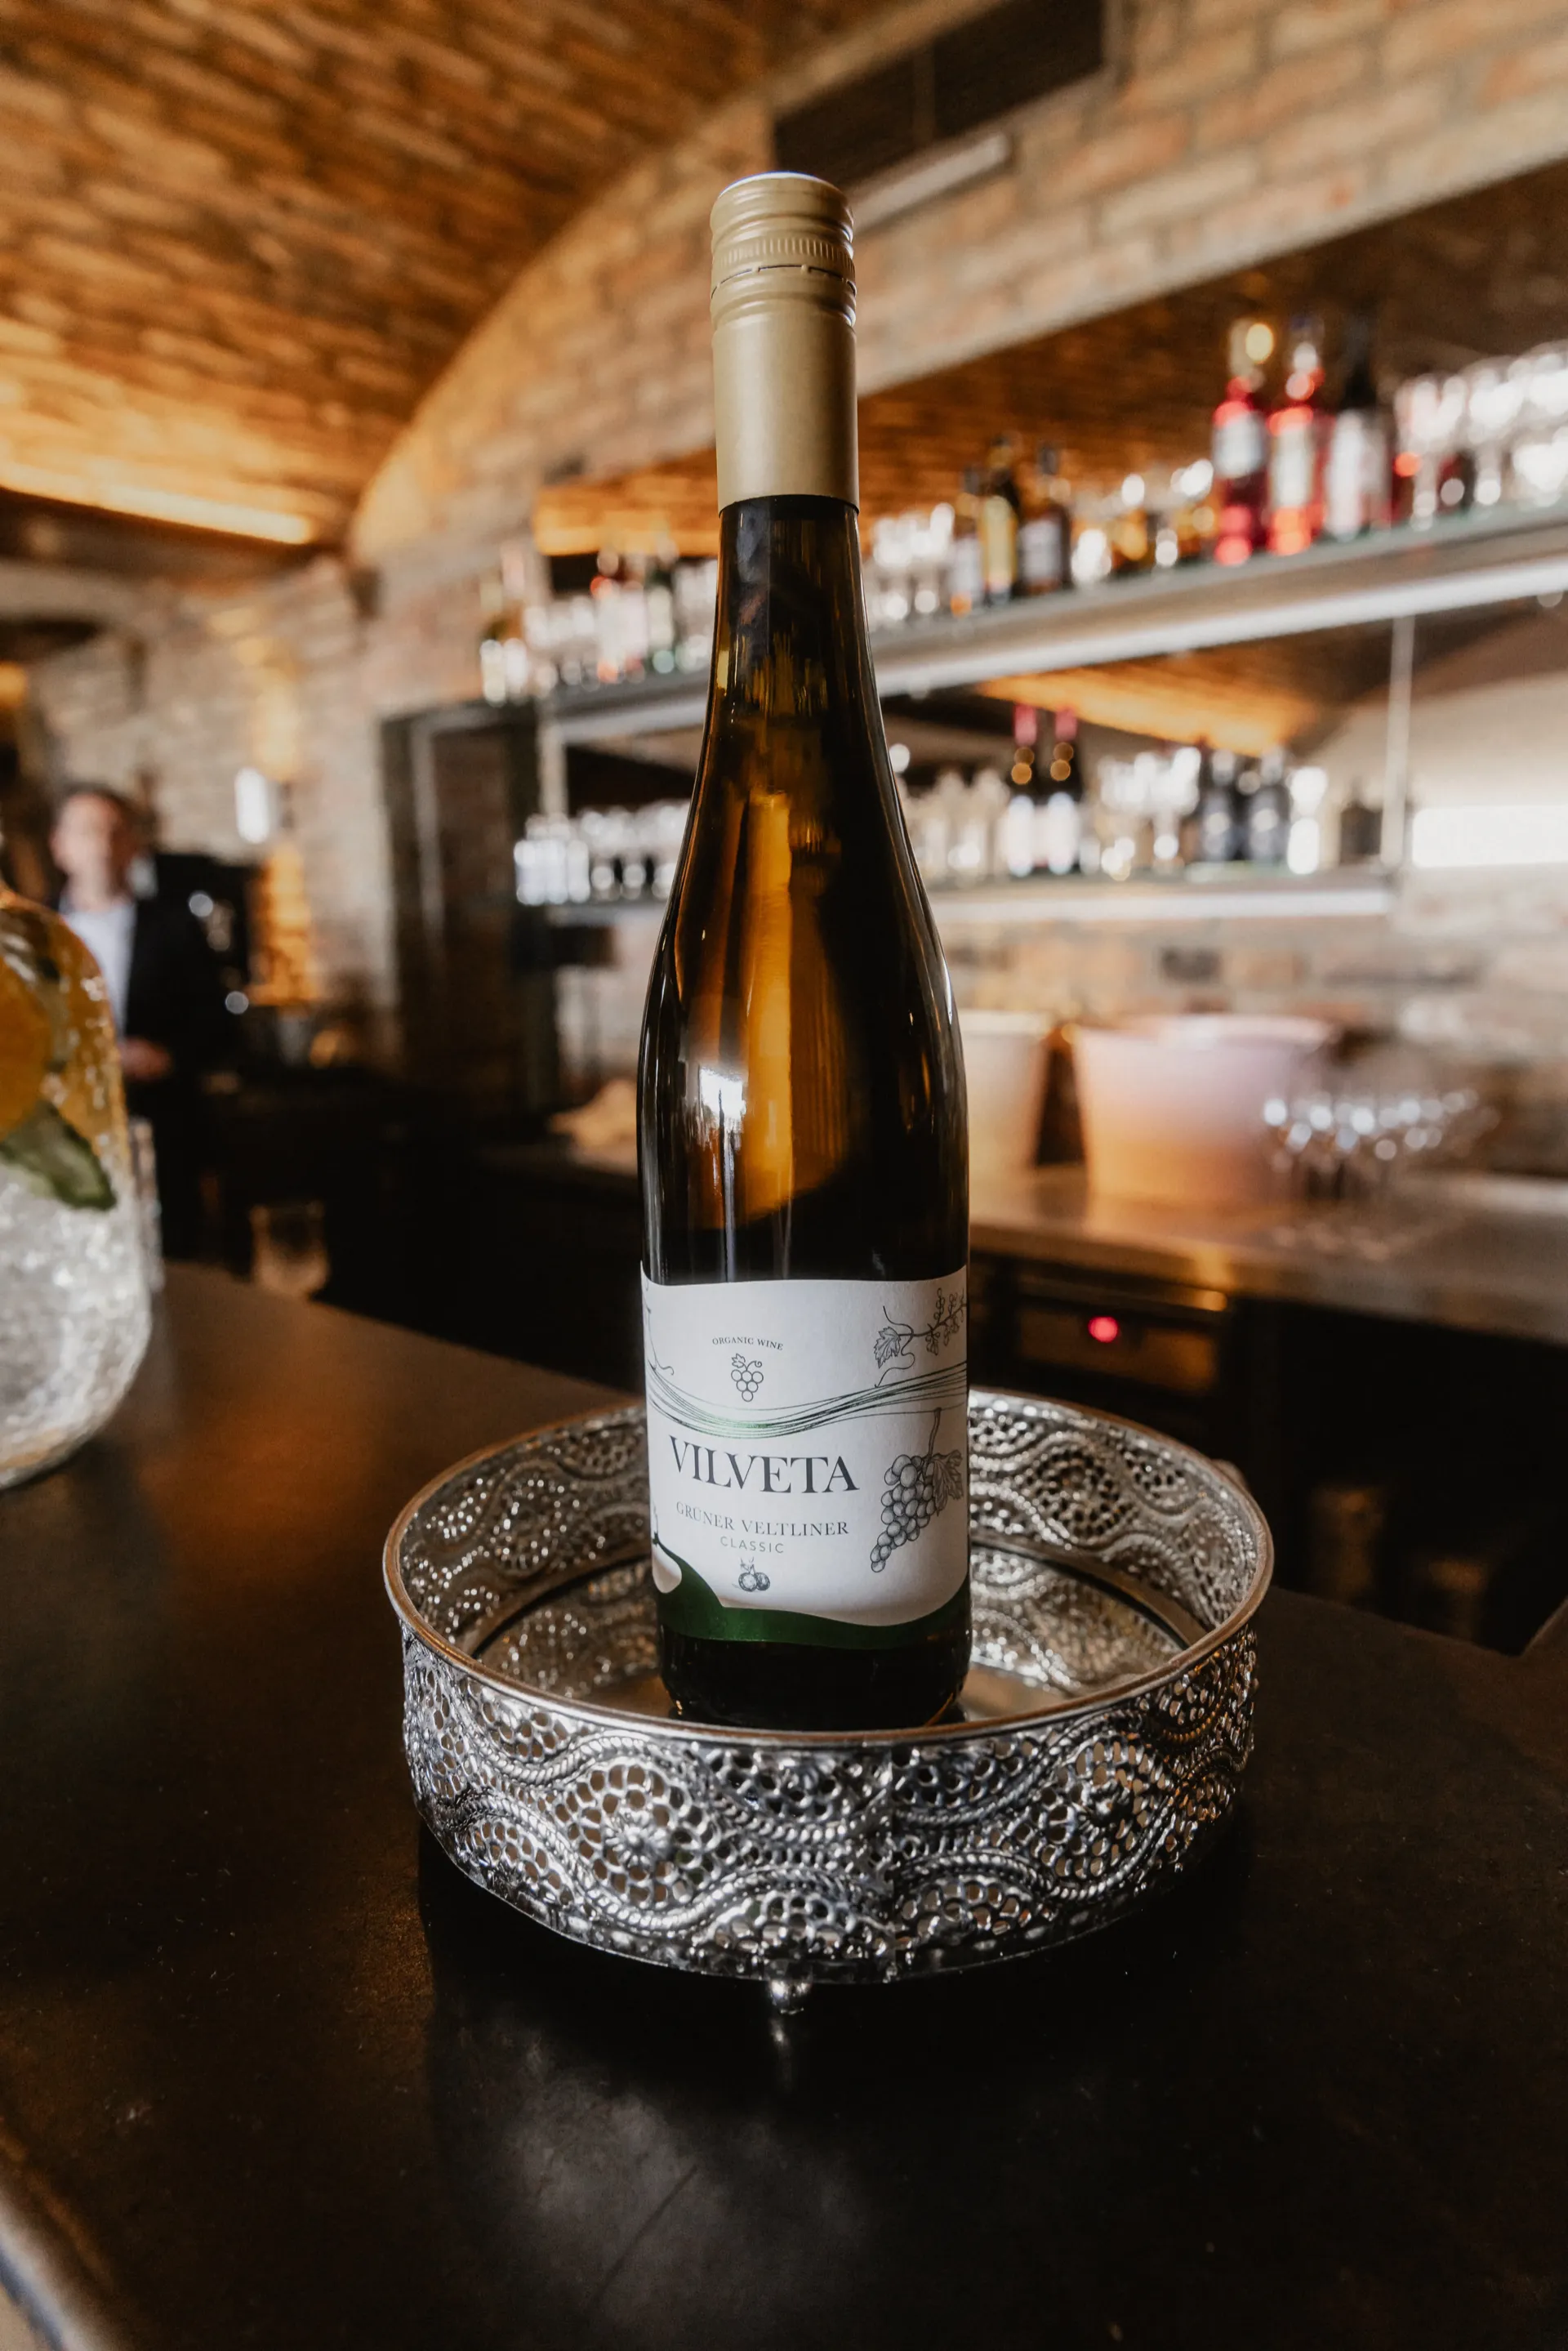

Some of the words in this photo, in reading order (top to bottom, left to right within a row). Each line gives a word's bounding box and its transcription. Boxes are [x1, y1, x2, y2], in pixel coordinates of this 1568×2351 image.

[712, 1336, 754, 1346] ORGANIC
[757, 1339, 783, 1350] WINE
[669, 1434, 860, 1493] VILVETA
[742, 1519, 849, 1536] VELTLINER
[720, 1536, 784, 1553] CLASSIC
